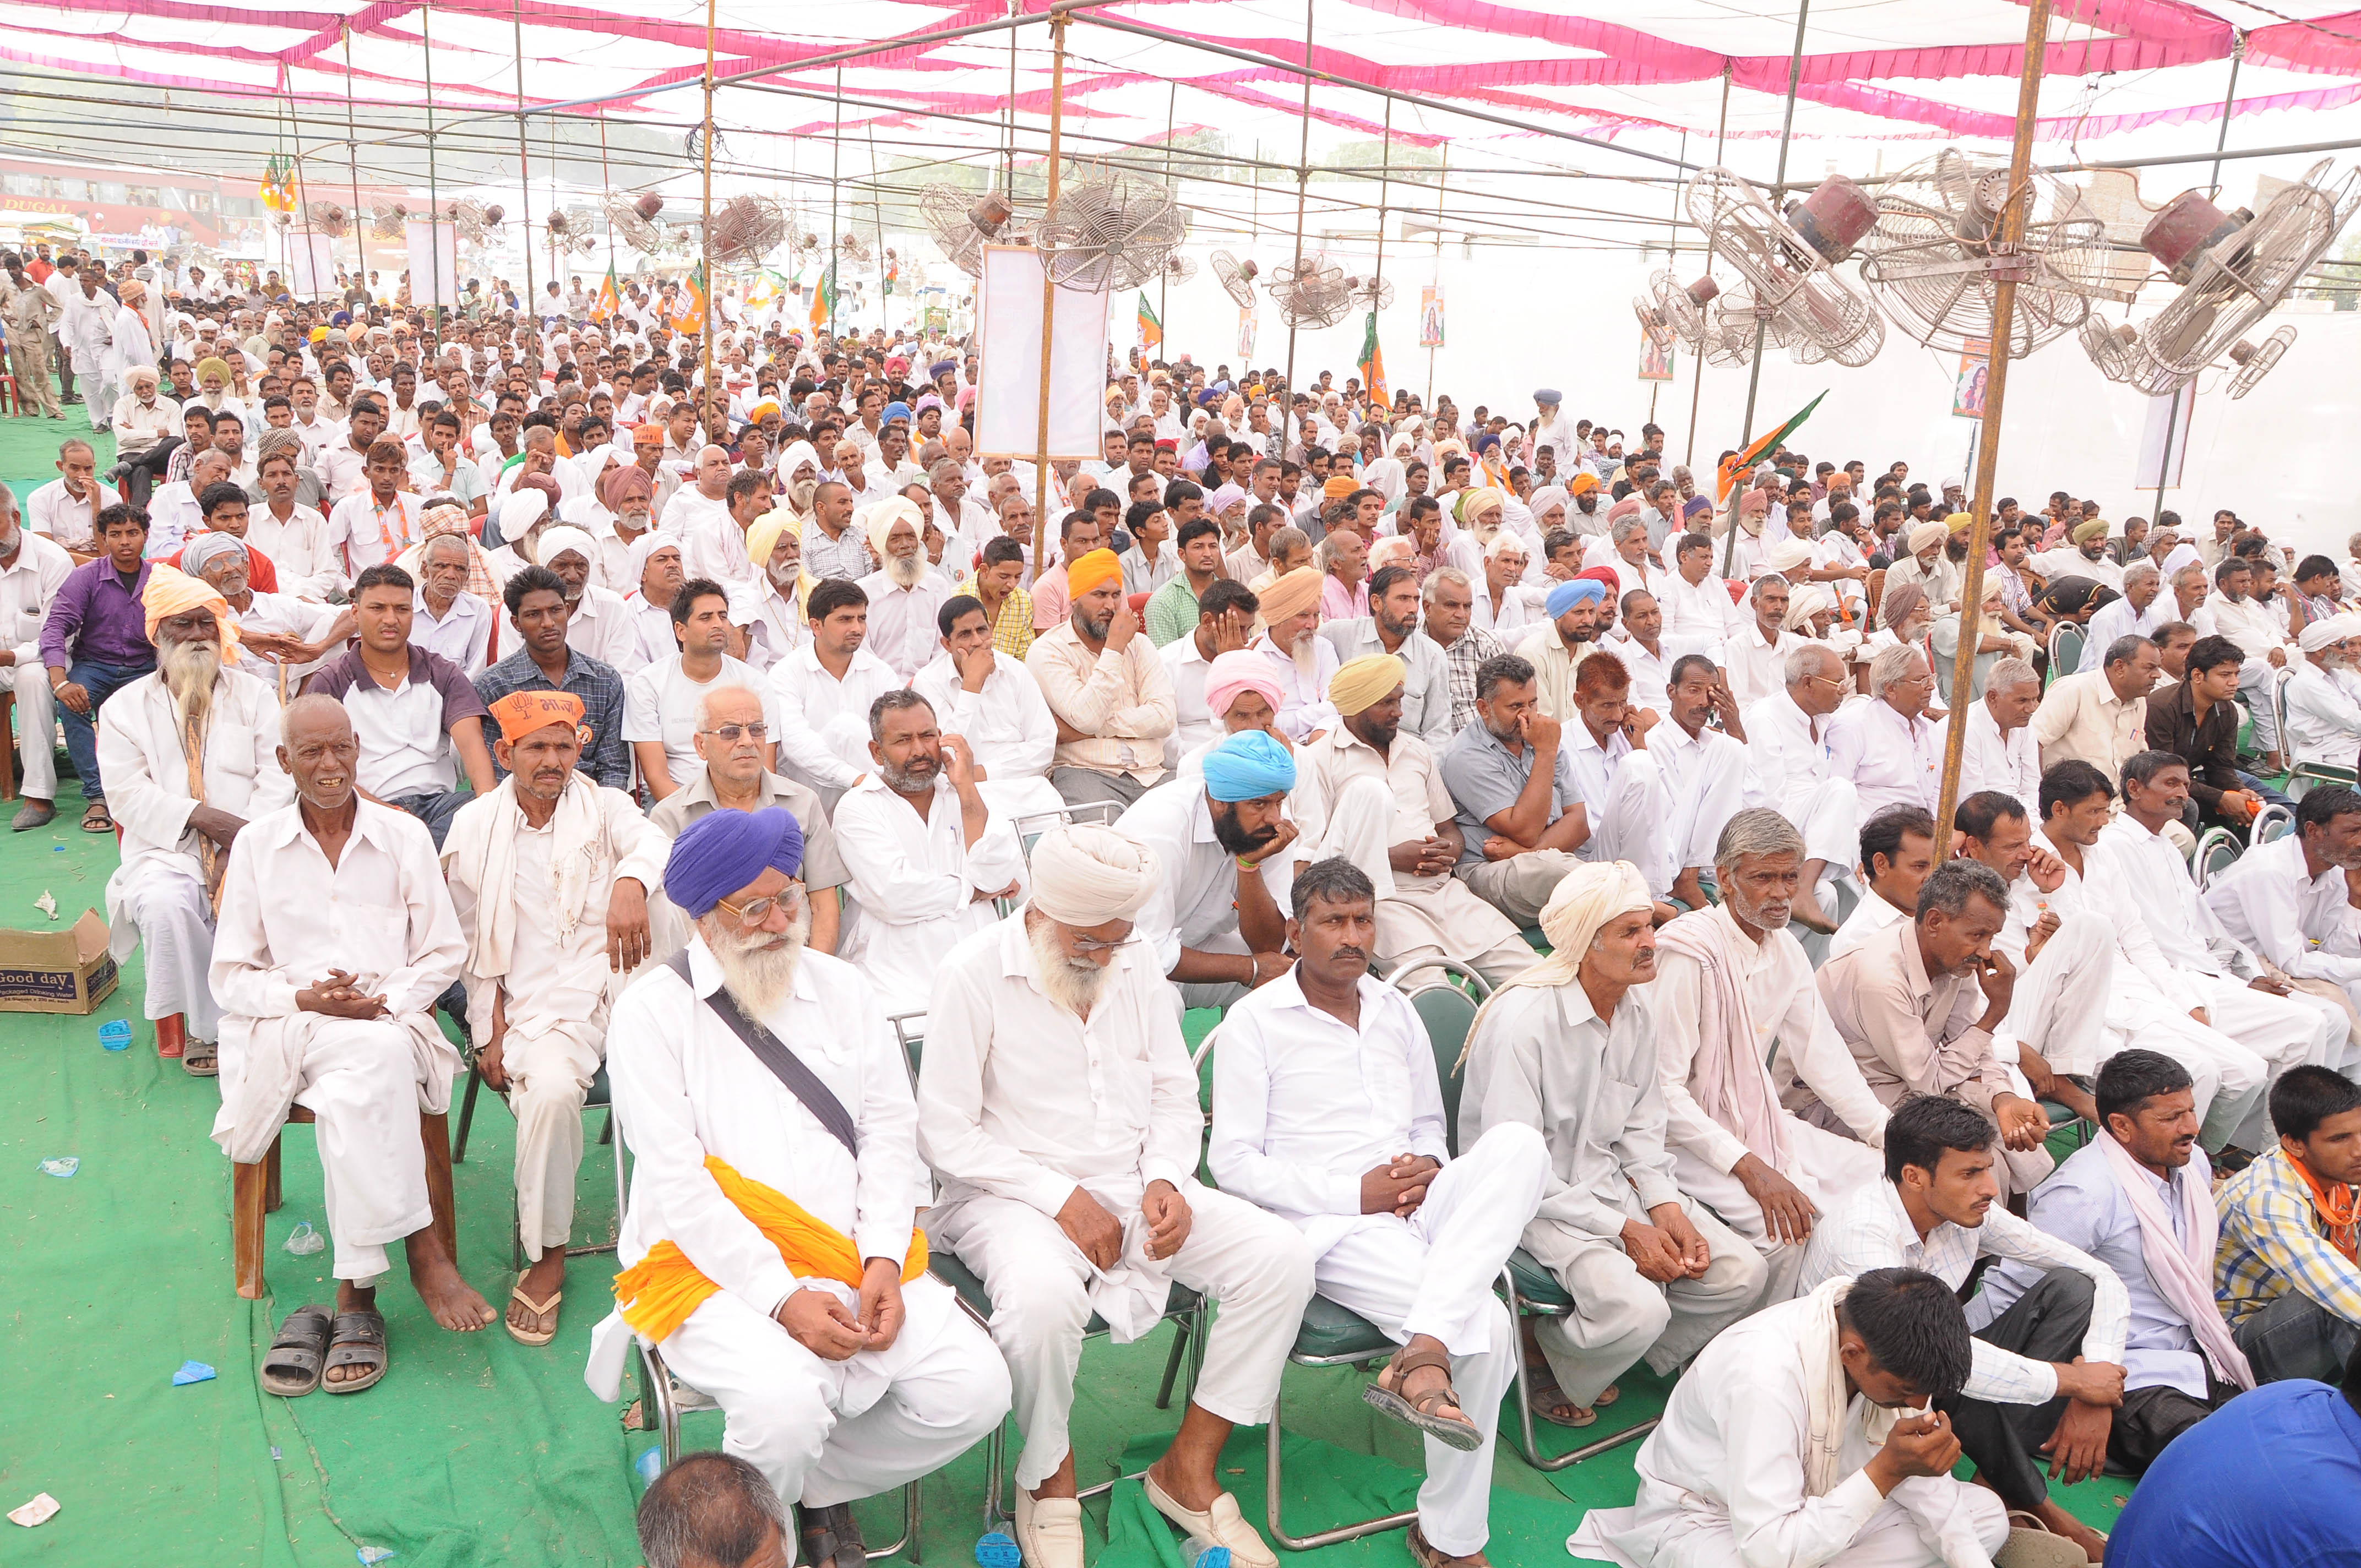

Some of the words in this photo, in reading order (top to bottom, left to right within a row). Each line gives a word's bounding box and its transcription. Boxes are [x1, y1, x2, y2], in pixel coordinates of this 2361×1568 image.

[4, 199, 72, 214] DUGAL
[0, 972, 35, 983] Good
[40, 973, 67, 990] day
[30, 989, 55, 997] Drinking
